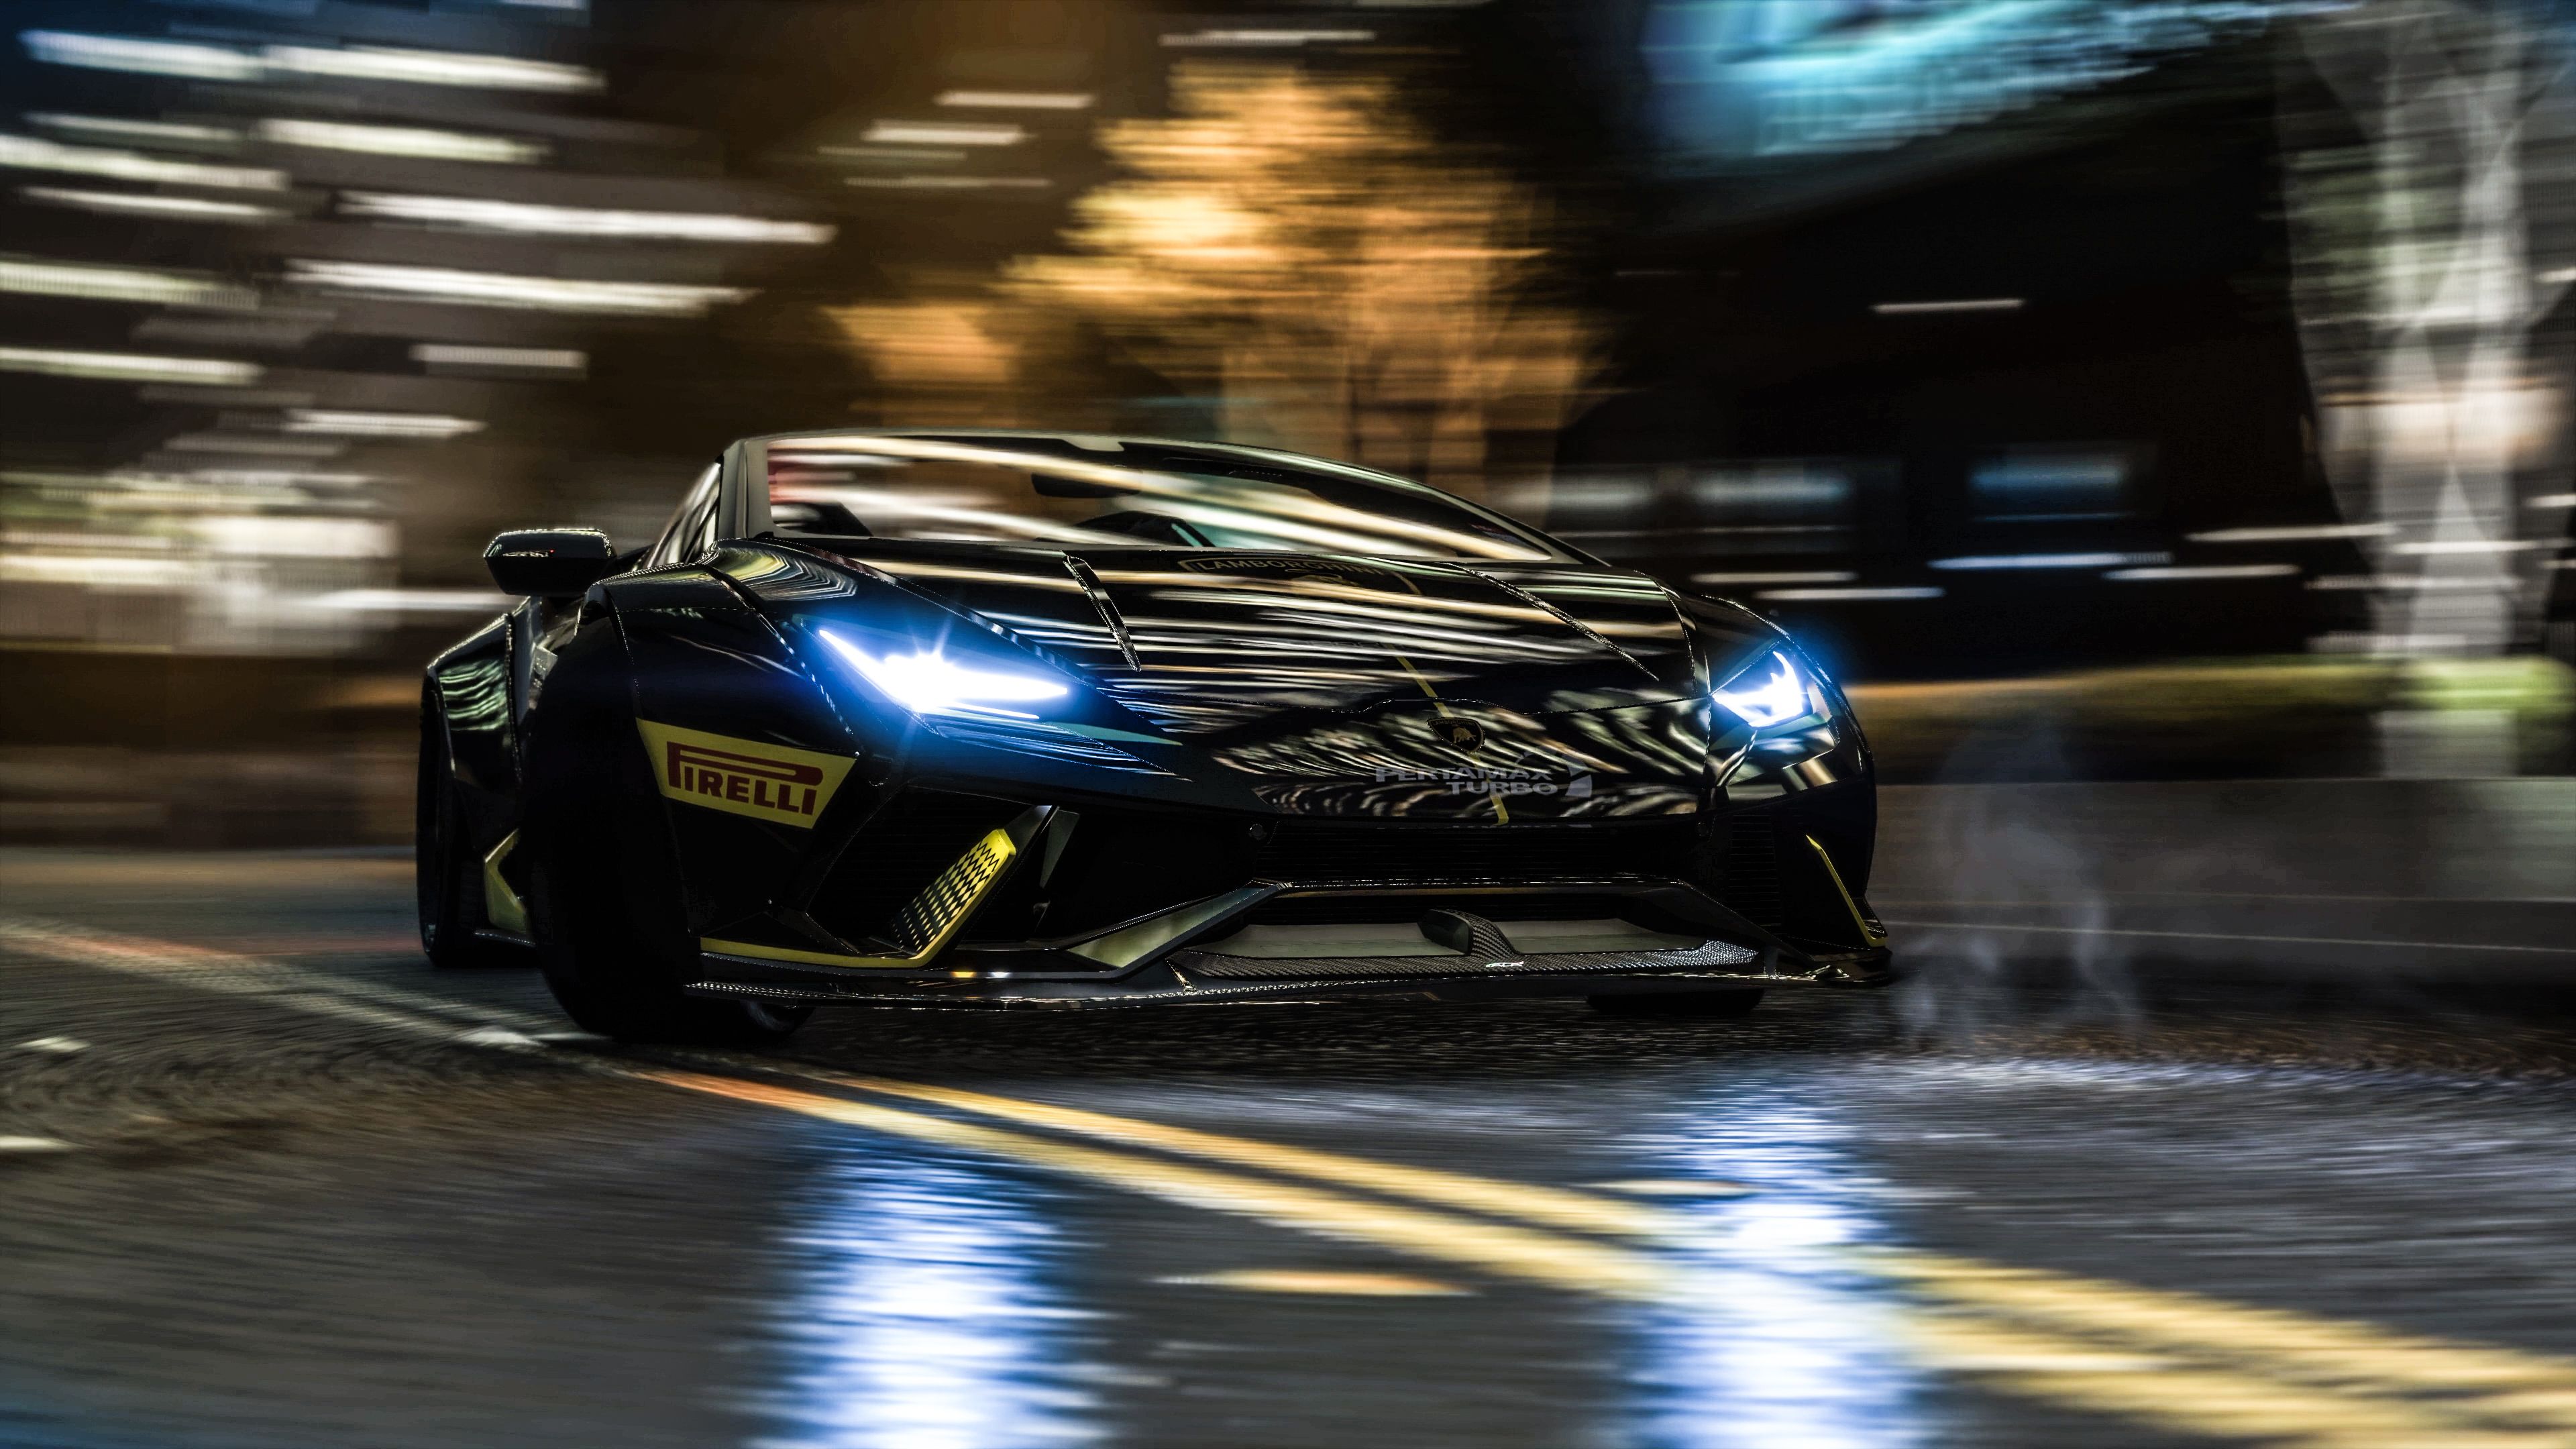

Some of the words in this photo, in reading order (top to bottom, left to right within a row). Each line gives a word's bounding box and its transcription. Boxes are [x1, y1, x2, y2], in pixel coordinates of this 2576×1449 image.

[1199, 559, 1384, 575] LAMBORGHINI
[667, 741, 824, 815] PIRELLI
[1375, 767, 1553, 782] PERTAMAX
[1446, 781, 1558, 796] TURBO
